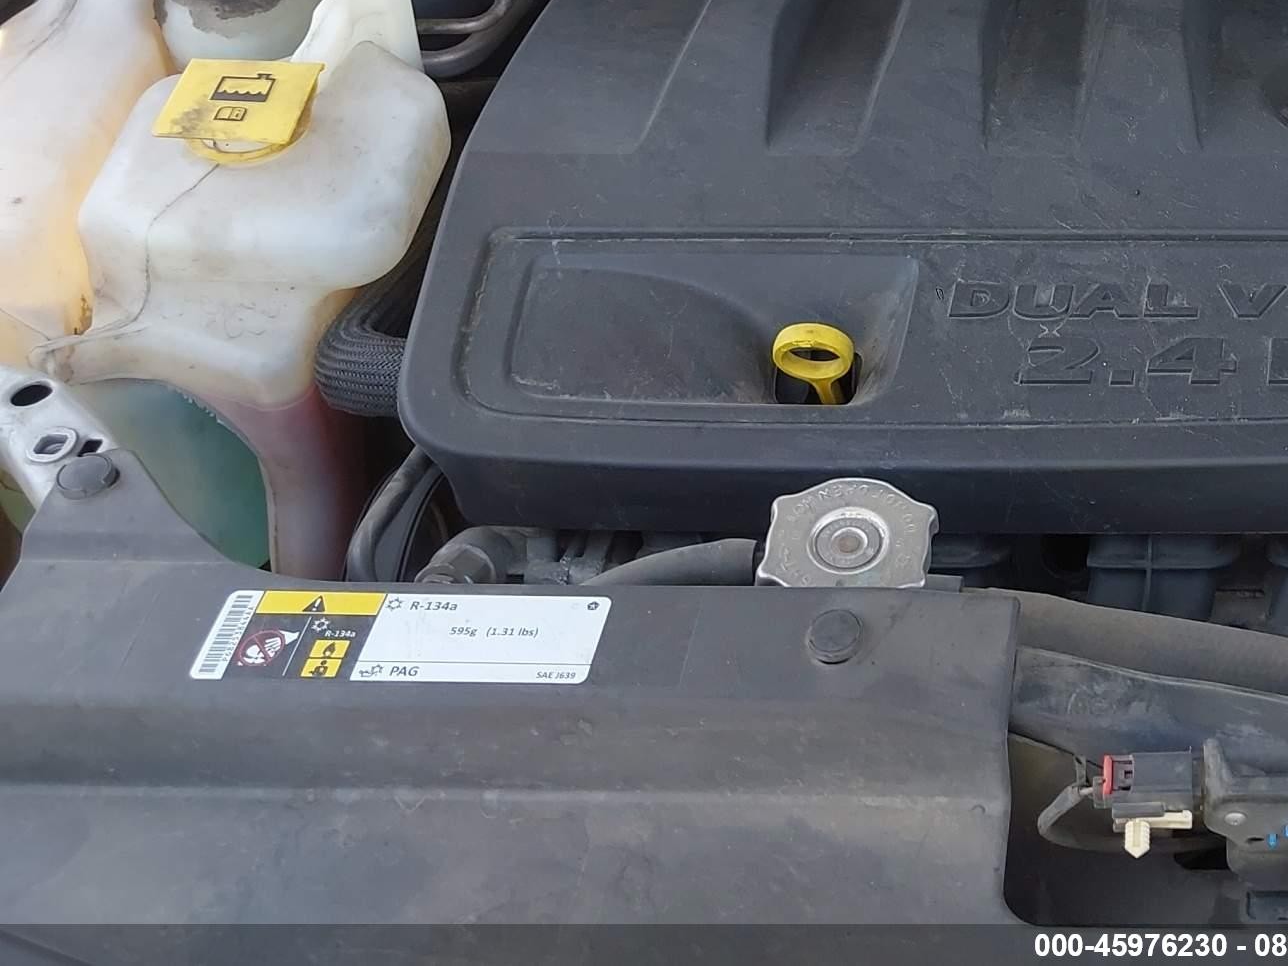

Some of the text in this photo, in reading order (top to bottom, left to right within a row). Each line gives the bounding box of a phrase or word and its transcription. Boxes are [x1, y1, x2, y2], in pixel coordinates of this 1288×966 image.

[948, 280, 1199, 320] DUAL
[410, 600, 458, 612] R-134a
[324, 630, 356, 638] R-134a
[449, 626, 539, 638] 595g (1.31 lbs)
[389, 665, 420, 677] PAG
[535, 671, 577, 681] SAE J639
